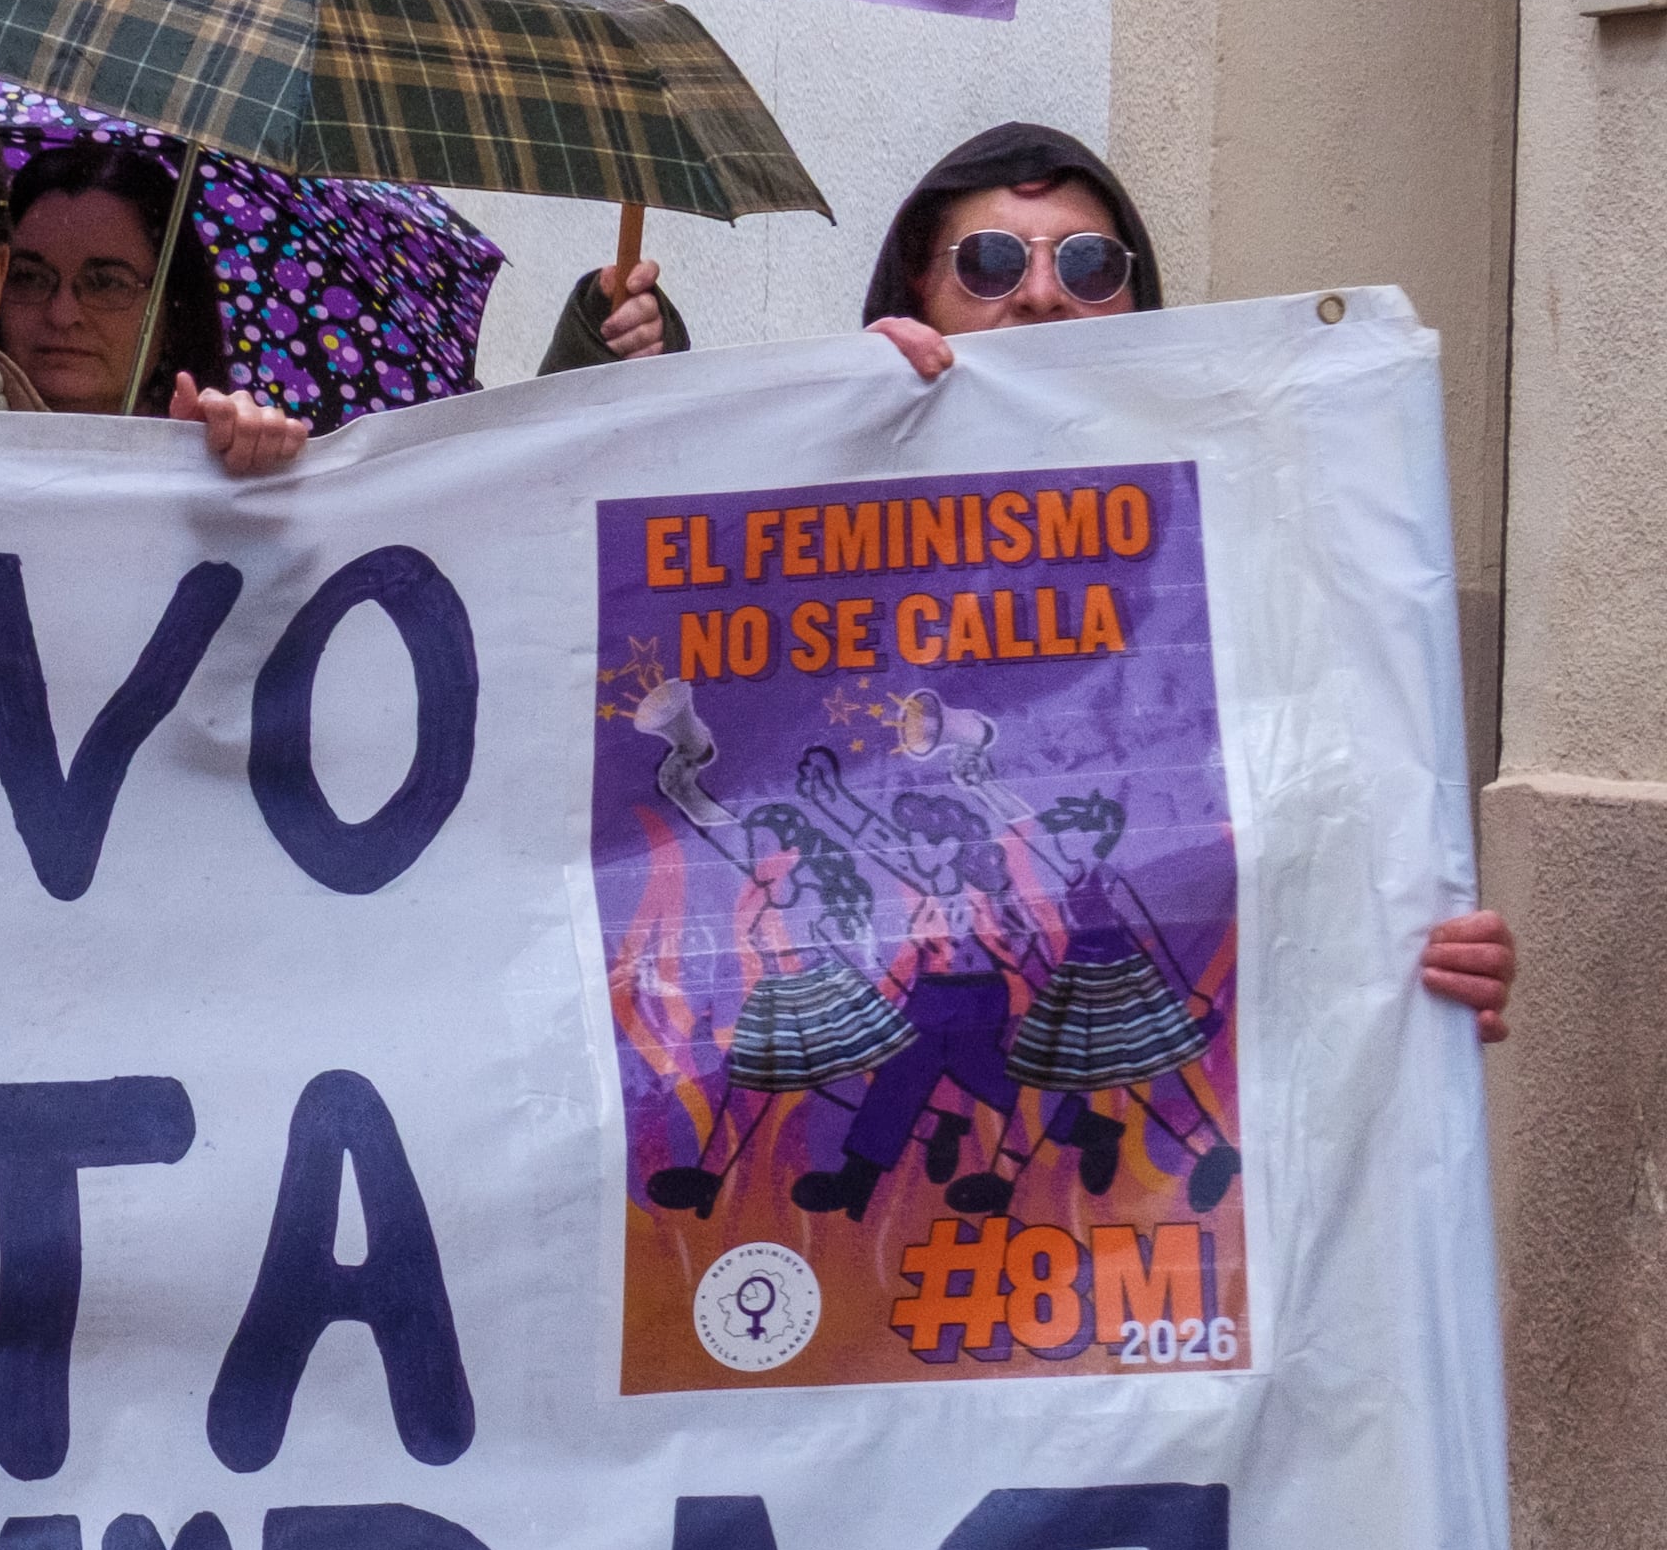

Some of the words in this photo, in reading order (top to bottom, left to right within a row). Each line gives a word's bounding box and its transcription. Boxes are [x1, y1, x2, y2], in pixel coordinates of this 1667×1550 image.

[645, 515, 726, 588] EL
[744, 483, 1152, 581] FEMINISMO
[679, 605, 771, 682] NO
[790, 598, 876, 673] SE
[896, 583, 1127, 665] CALLA
[890, 1216, 1209, 1355] #8M
[1119, 1316, 1239, 1365] 2026
